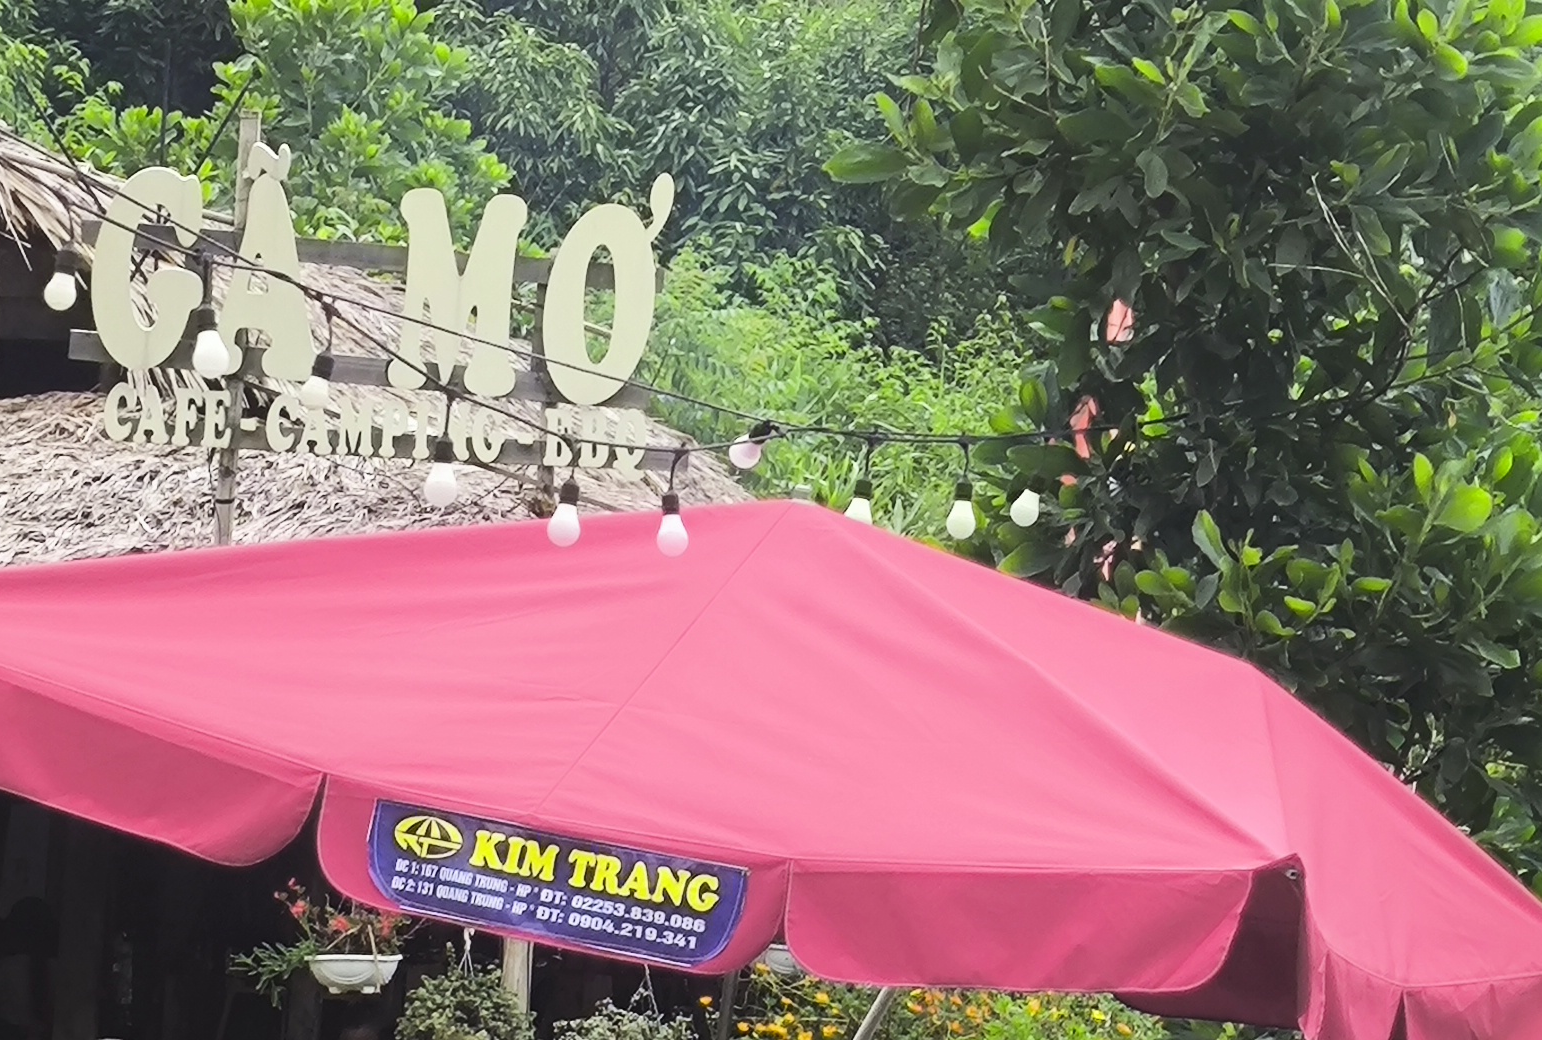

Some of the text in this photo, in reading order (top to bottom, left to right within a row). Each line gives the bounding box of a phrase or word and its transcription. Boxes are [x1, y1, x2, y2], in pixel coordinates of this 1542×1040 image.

[387, 172, 674, 406] MƠ
[420, 863, 439, 878] 167
[439, 866, 474, 886] QUANG
[474, 873, 509, 893] TRUNG
[516, 883, 532, 898] HP
[571, 894, 706, 933] 02253.839.086
[469, 829, 720, 913] KIM TRANG
[417, 880, 435, 896] 131
[436, 884, 470, 903] QUANG
[470, 891, 505, 911] TRUNG
[512, 900, 528, 916] HP
[568, 912, 697, 950] 0904.219.341
